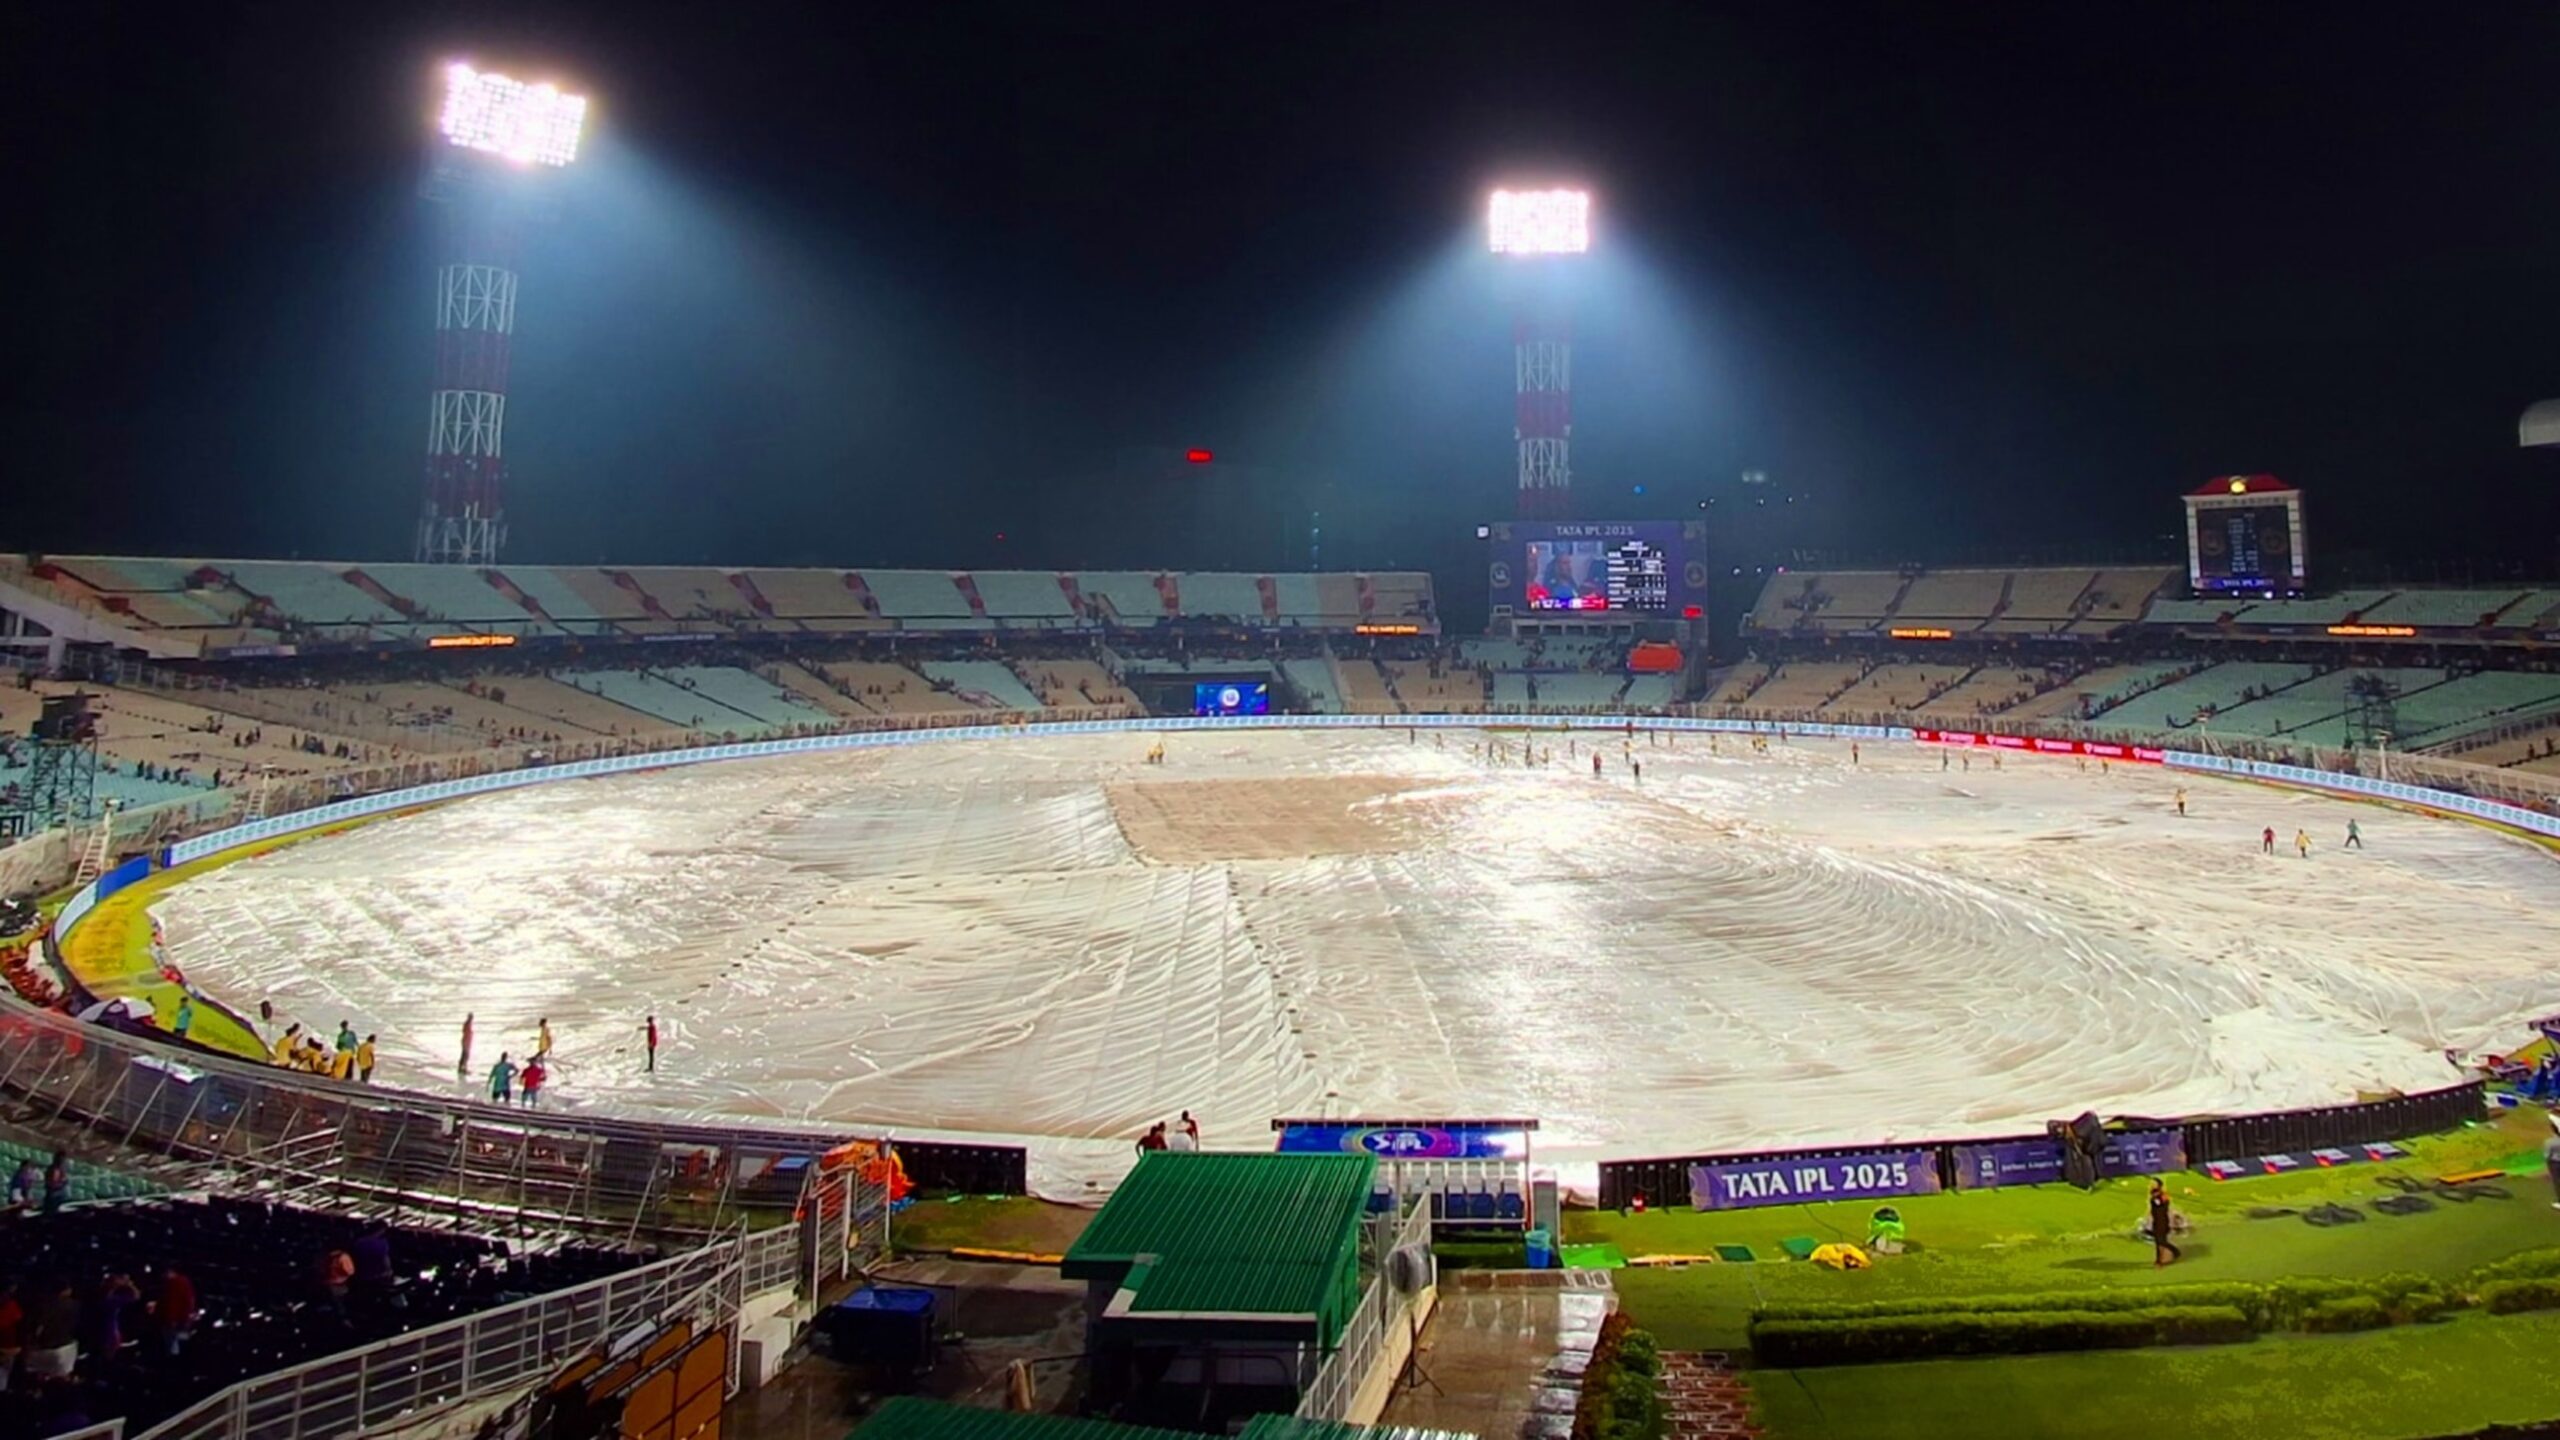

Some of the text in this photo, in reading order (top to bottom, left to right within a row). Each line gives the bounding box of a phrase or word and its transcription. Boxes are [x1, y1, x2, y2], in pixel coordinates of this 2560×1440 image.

[1722, 1163, 1908, 1198] TATA IPL 2025
